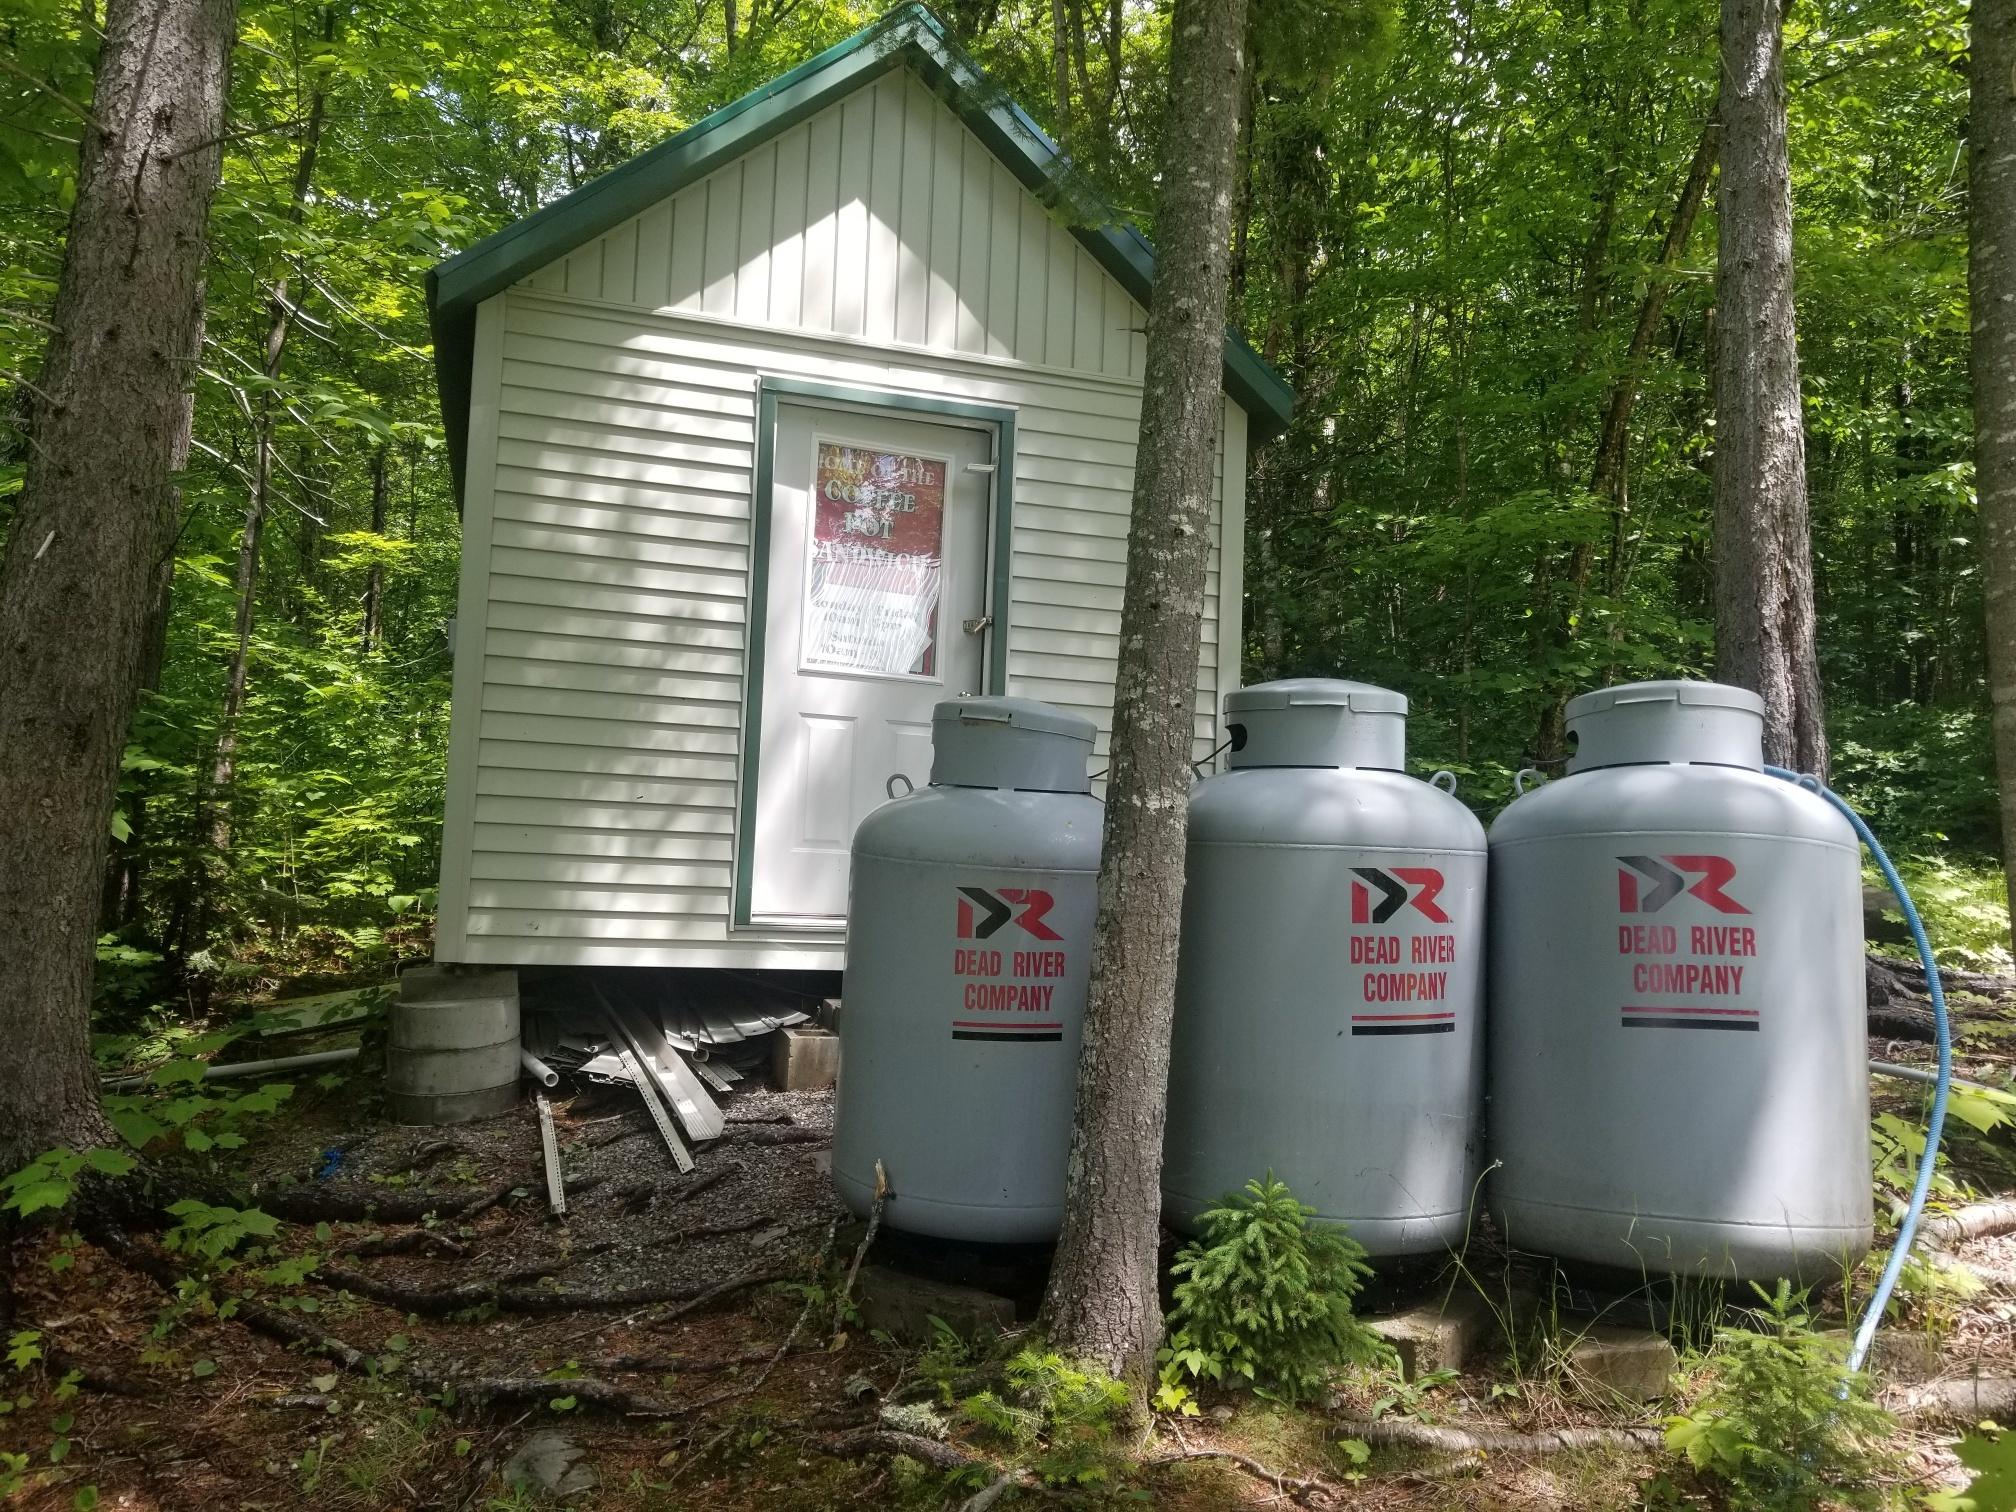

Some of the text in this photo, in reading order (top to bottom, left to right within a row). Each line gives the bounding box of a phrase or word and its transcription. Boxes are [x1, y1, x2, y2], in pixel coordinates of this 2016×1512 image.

[819, 452, 867, 475] HOE
[901, 467, 936, 486] THE
[843, 511, 896, 540] POT
[1350, 935, 1456, 965] DEAD RIVER
[1618, 925, 1757, 957] DEAD RIVER
[954, 949, 1065, 978] DEAD RIVER
[1633, 962, 1744, 995] COMPANY
[963, 983, 1054, 1012] COMPANY
[1362, 971, 1447, 1002] COMPANY
